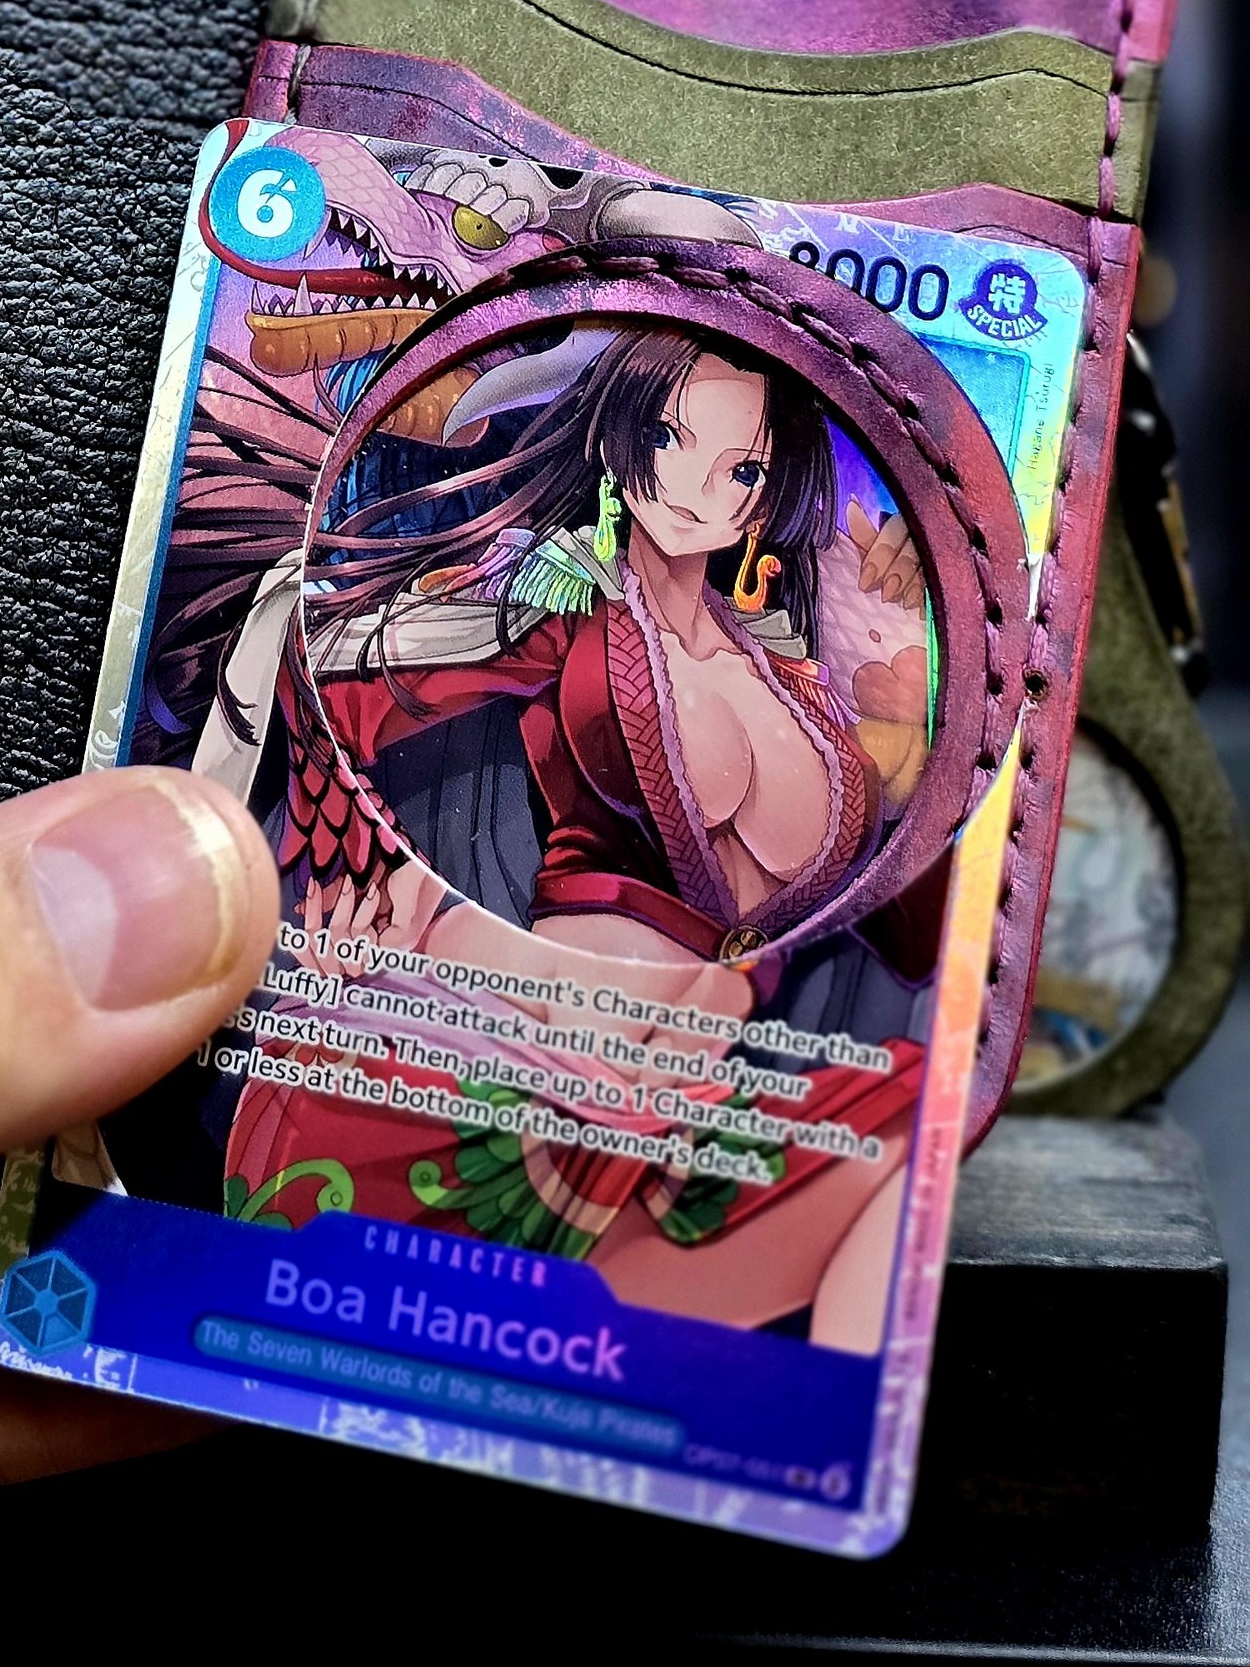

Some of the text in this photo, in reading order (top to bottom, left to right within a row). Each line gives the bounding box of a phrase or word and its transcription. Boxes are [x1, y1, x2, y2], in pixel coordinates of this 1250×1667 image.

[237, 168, 297, 238] 6
[966, 304, 1043, 338] SPECIAL
[987, 273, 1026, 314] 特
[280, 926, 890, 1069] to 1 of your opponent's Characters other than
[346, 987, 442, 1020] cannot
[444, 1002, 527, 1040] attack
[535, 1025, 595, 1055] until
[602, 1037, 647, 1065] the
[653, 1050, 705, 1077] end
[711, 1059, 745, 1084] of
[747, 1070, 809, 1098] your
[217, 1050, 246, 1070] or
[251, 1050, 300, 1082] less
[307, 1067, 334, 1090] at
[342, 1072, 384, 1101] the
[391, 1081, 491, 1124] bottom
[495, 1105, 529, 1130] of
[531, 1110, 576, 1140] the
[578, 1125, 689, 1165] owner's
[696, 1146, 770, 1182] deck.
[259, 1014, 320, 1042] next
[325, 1023, 386, 1057] turn.
[395, 1036, 472, 1076] Then,
[473, 1058, 548, 1090] place
[552, 1076, 588, 1101] up
[595, 1079, 623, 1107] to
[634, 1087, 644, 1109] 1
[654, 1091, 786, 1141] Character
[793, 1119, 857, 1151] with
[862, 1138, 880, 1159] a
[364, 1224, 547, 1288] CHARACTER
[201, 1320, 240, 1351] The
[247, 1329, 312, 1367] Seven
[321, 1345, 413, 1389] Warlords
[418, 1370, 443, 1394] of
[448, 1377, 483, 1405] the
[265, 1259, 627, 1383] Boa Hancock
